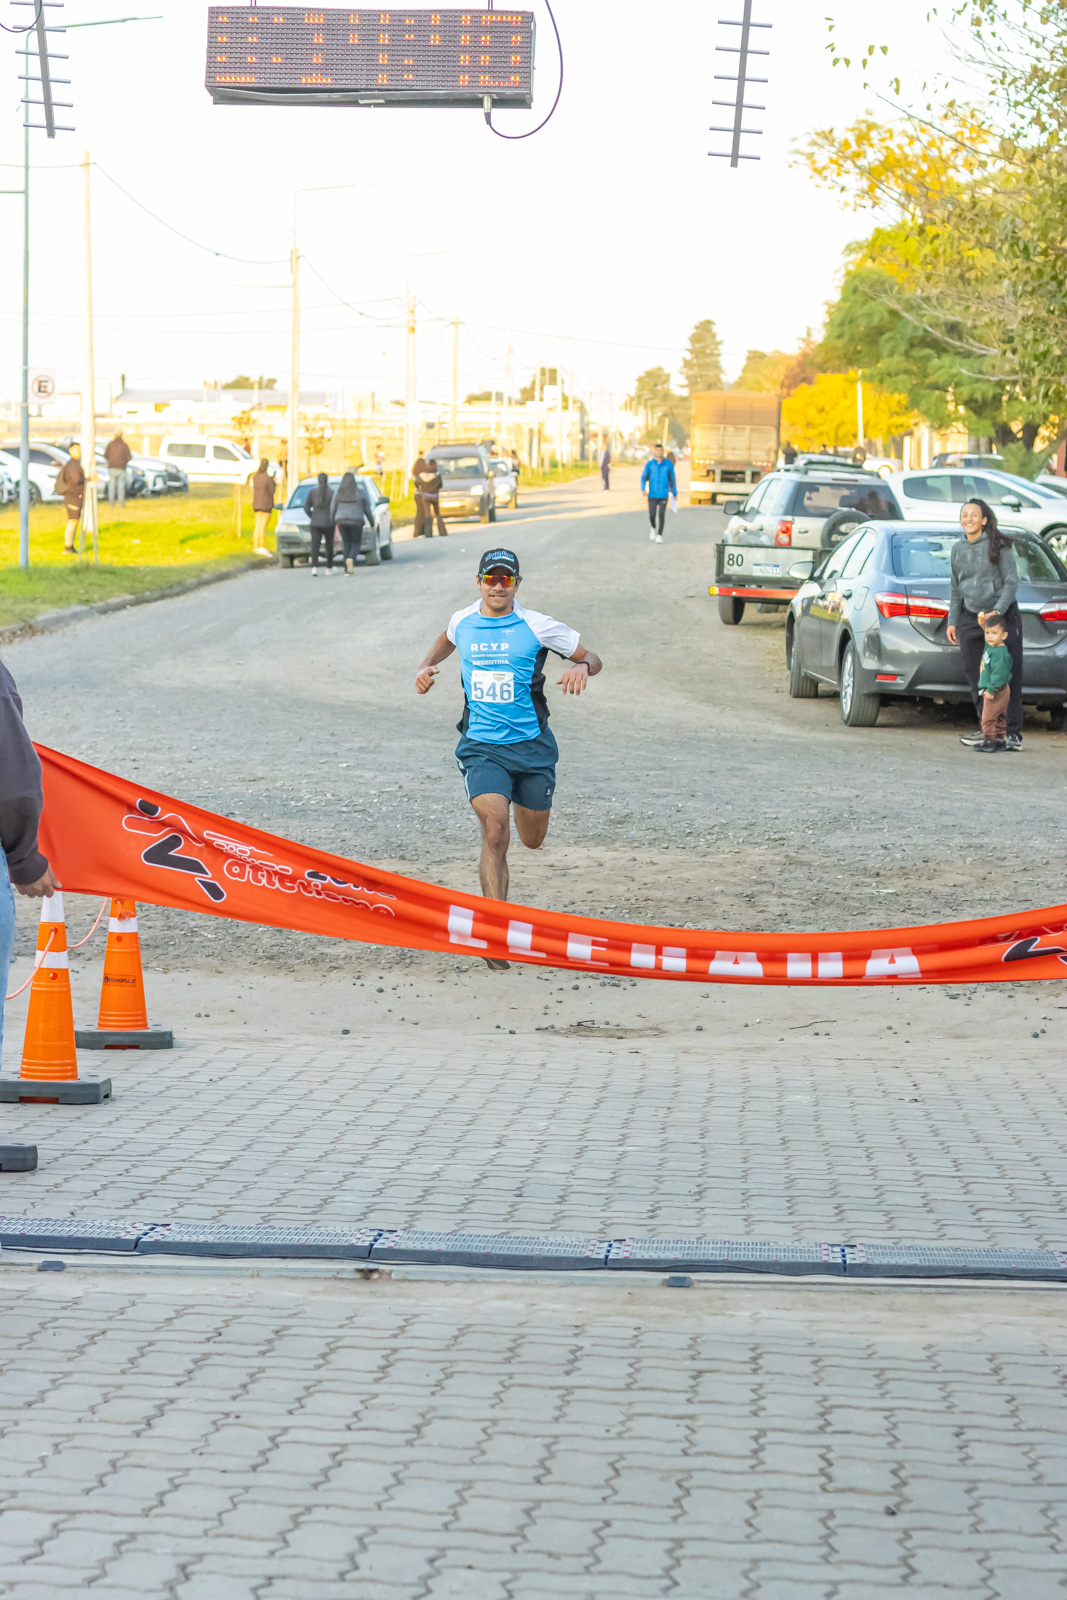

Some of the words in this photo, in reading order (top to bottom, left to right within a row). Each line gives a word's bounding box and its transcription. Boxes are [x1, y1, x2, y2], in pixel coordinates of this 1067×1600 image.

[727, 553, 744, 567] 80
[470, 642, 510, 652] RCYP
[473, 681, 512, 702] 546
